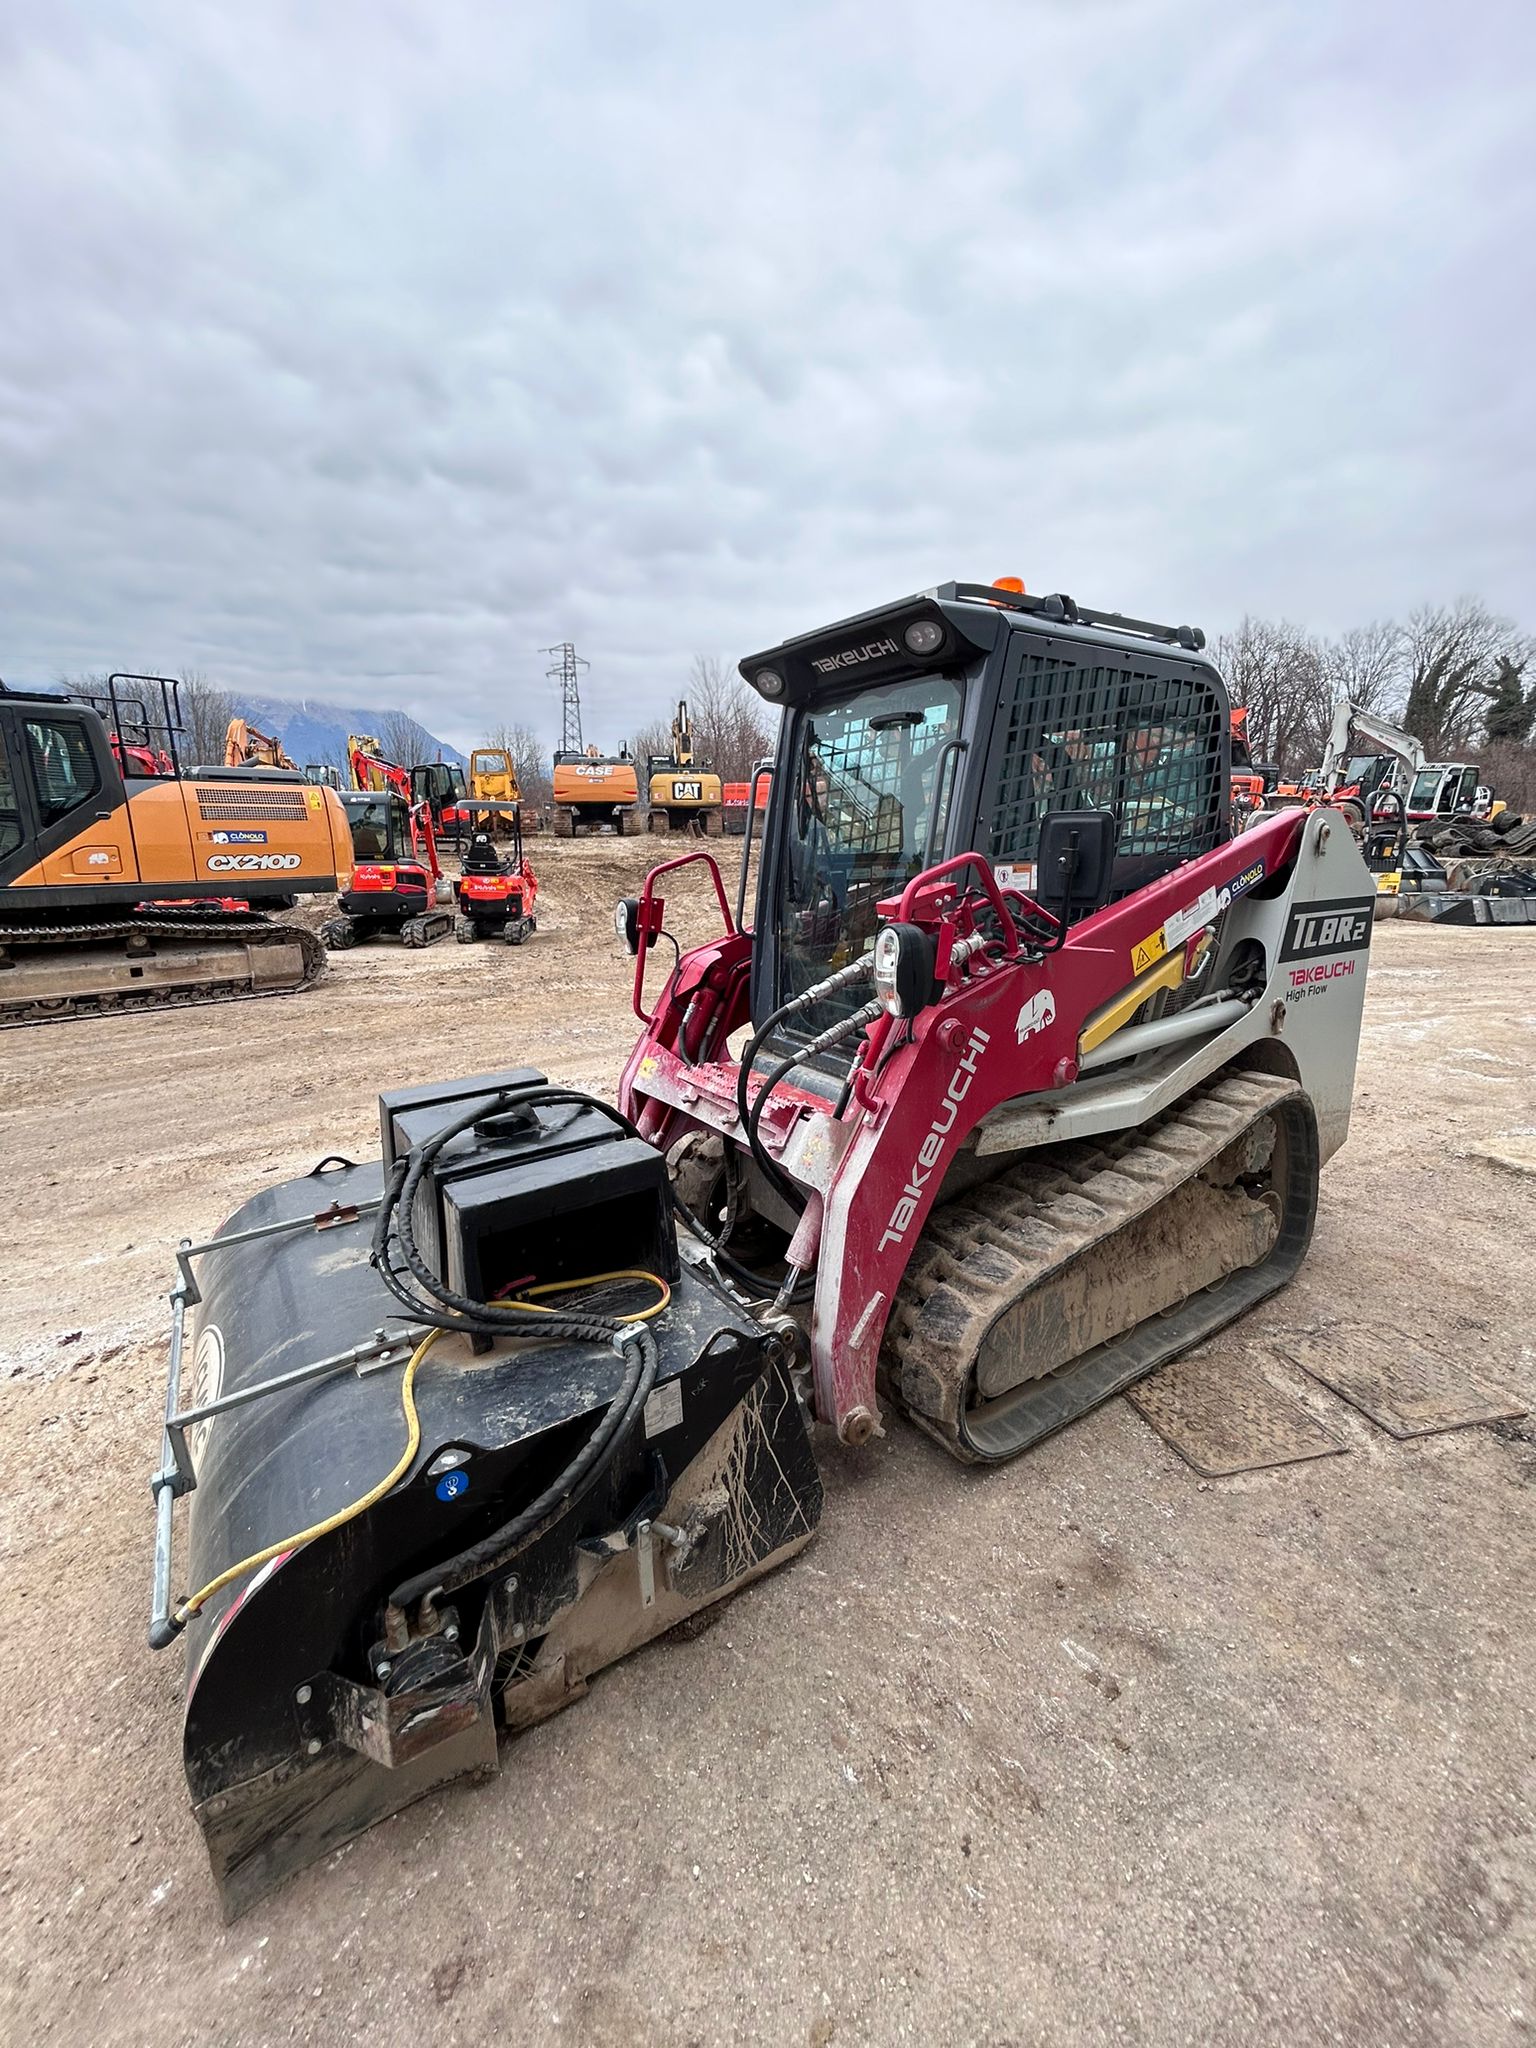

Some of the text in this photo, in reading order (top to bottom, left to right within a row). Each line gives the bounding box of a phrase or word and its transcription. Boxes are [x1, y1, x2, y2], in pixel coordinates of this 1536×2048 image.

[575, 766, 614, 776] CASE
[674, 782, 700, 800] CAT
[207, 854, 302, 871] CX210D
[1286, 984, 1328, 1002] High Flow
